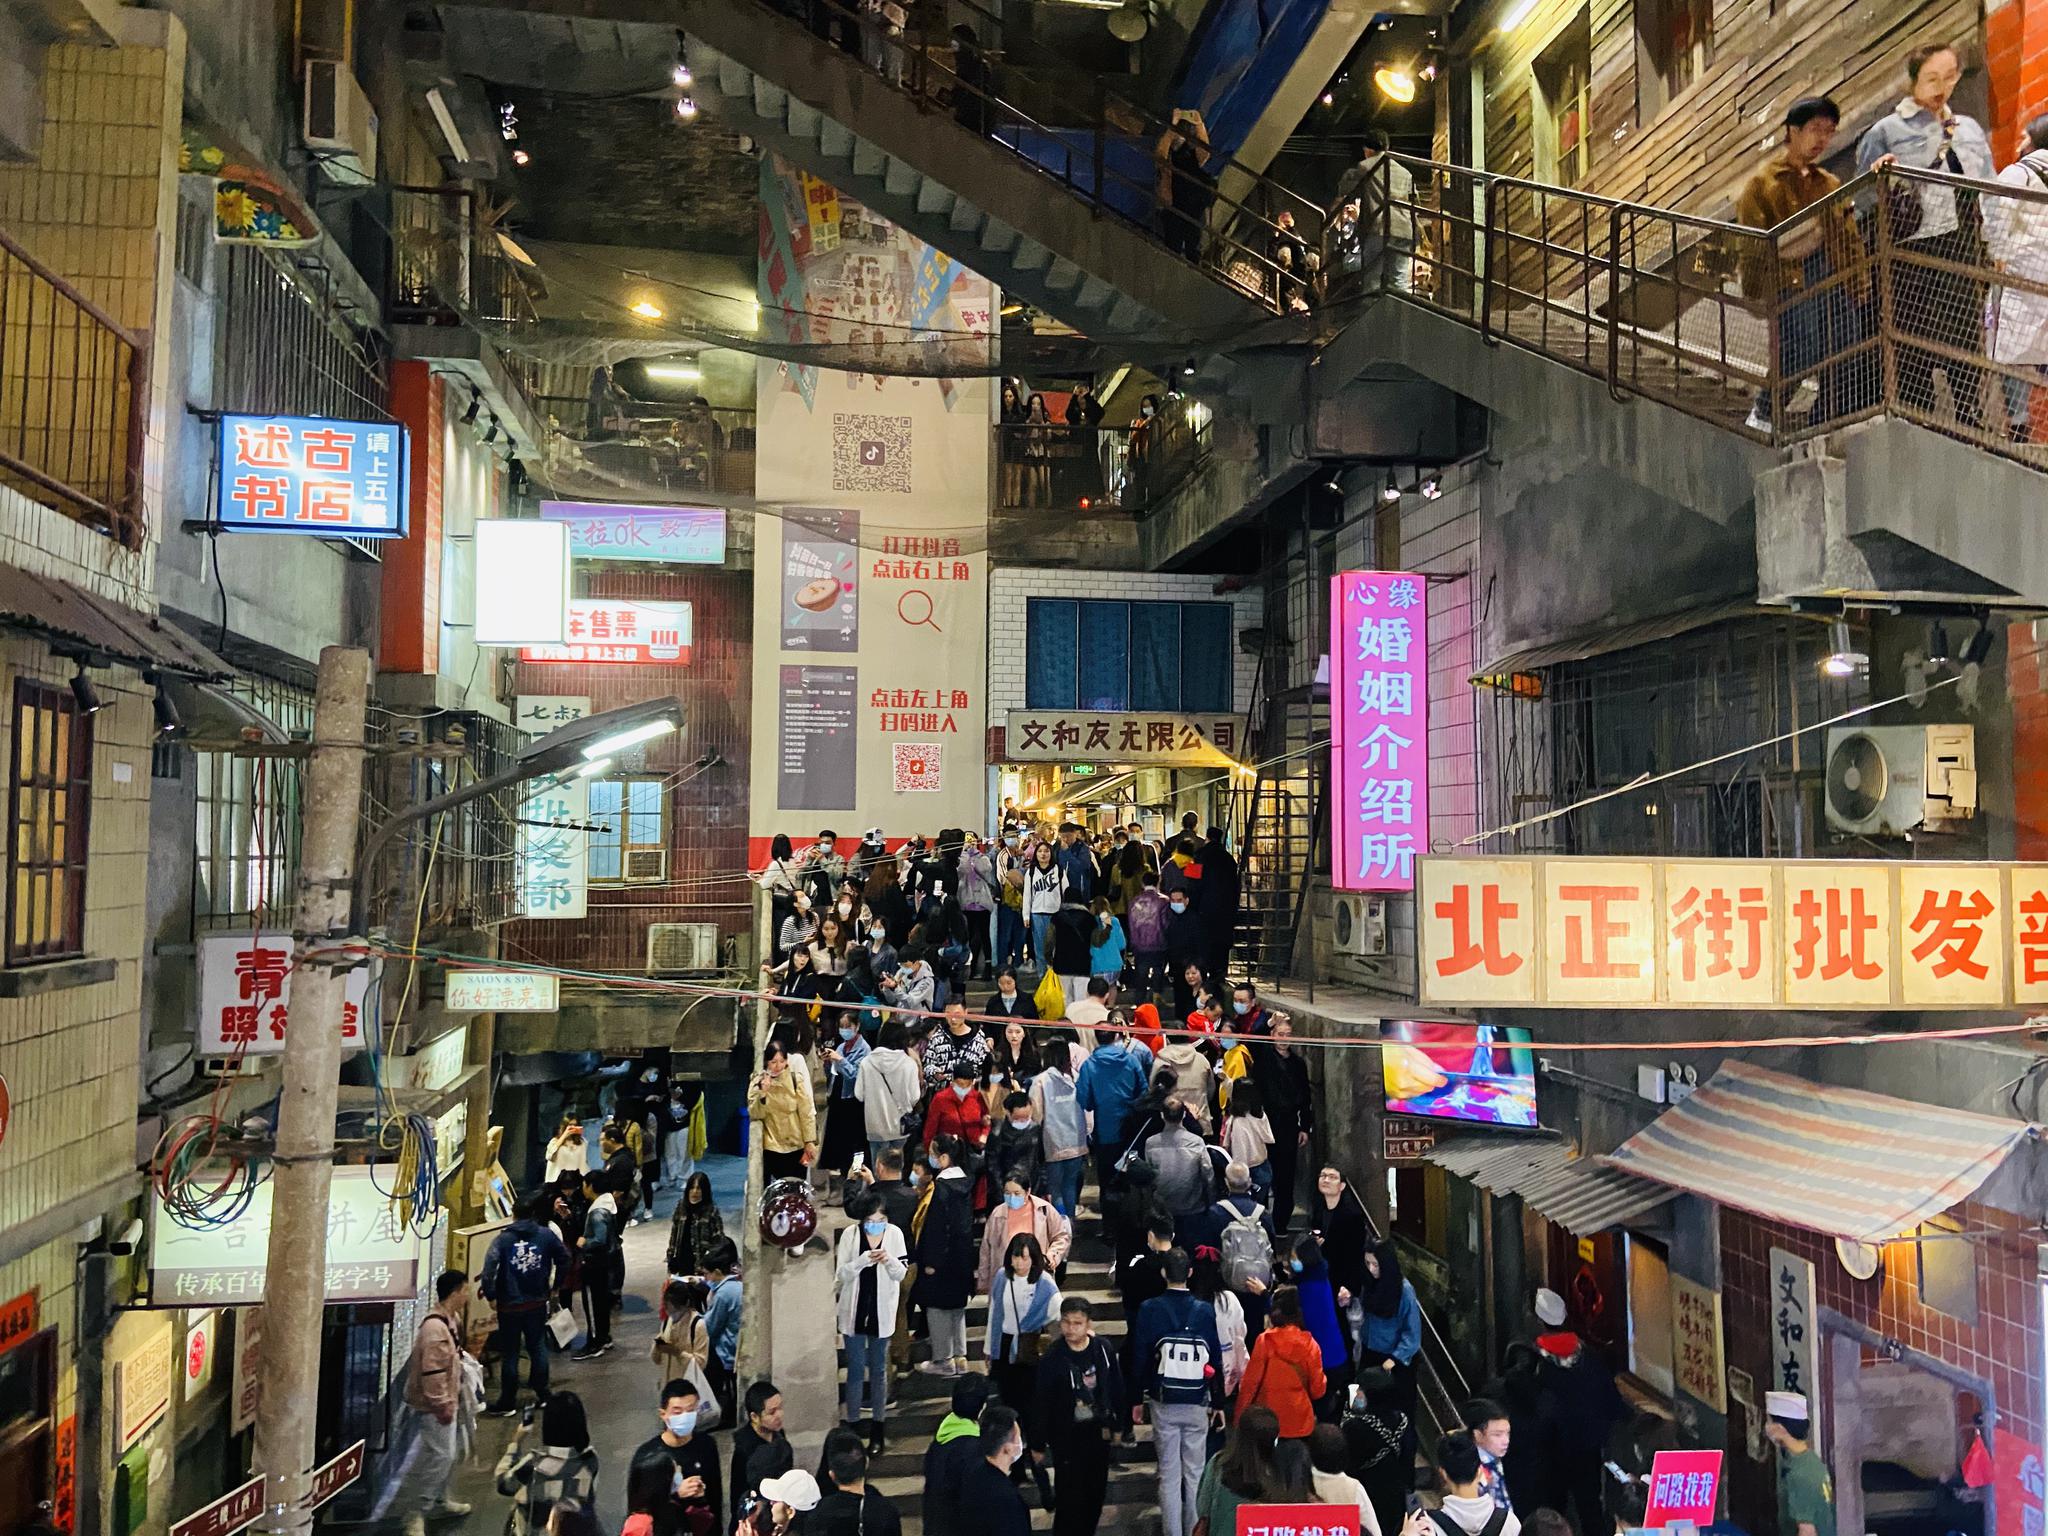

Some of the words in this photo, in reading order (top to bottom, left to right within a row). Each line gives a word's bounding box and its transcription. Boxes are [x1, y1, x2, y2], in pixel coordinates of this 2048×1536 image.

[234, 425, 356, 473] 述古
[232, 473, 353, 523] 书店
[882, 535, 960, 556] 打开抖音
[872, 559, 969, 580] 点击右上角
[1348, 579, 1420, 610] 心缘
[871, 688, 968, 709] 点击左上角
[880, 712, 958, 733] 扫码进入
[1020, 720, 1235, 751] 文和友无限公司
[1356, 616, 1416, 880] 婚姻介绍所
[1033, 873, 1055, 895] NIKE
[466, 975, 501, 984] SALON
[515, 975, 534, 984] SPA
[1653, 1472, 1714, 1508] 问路找我
